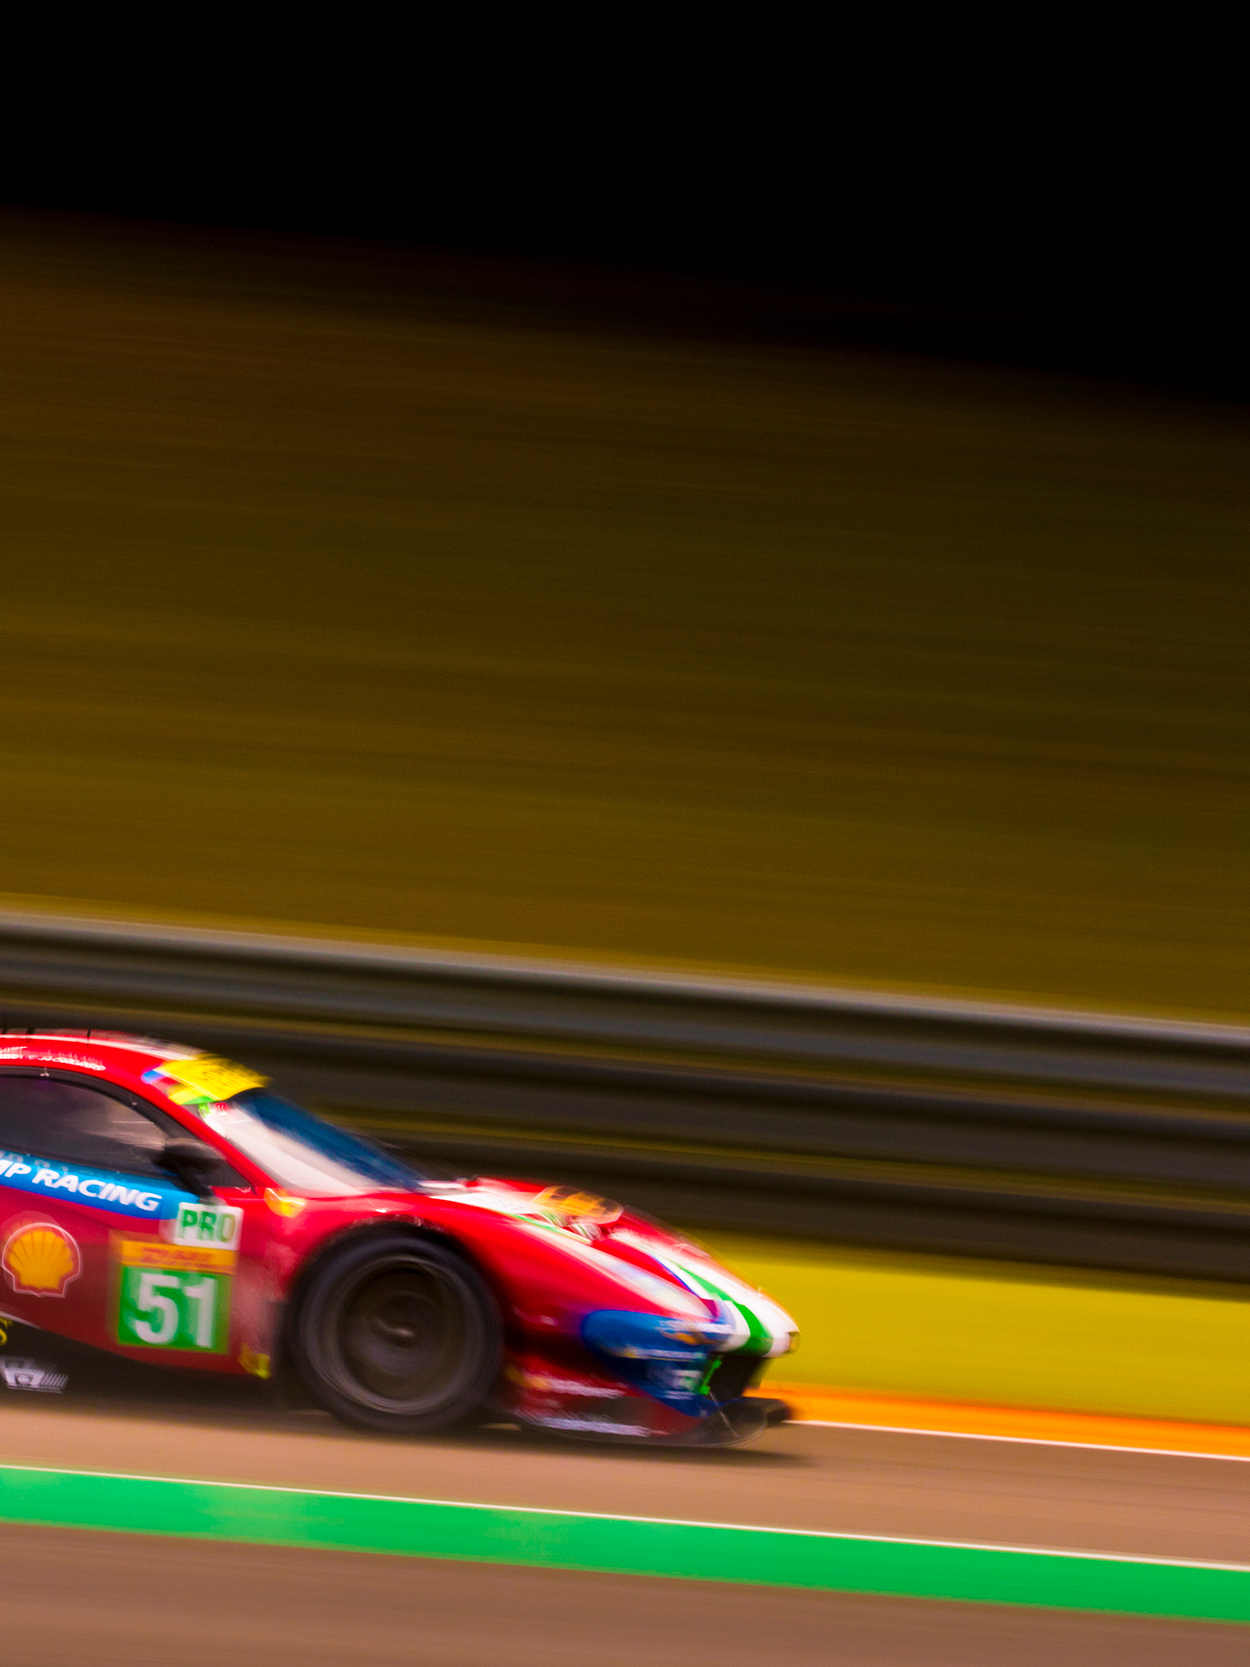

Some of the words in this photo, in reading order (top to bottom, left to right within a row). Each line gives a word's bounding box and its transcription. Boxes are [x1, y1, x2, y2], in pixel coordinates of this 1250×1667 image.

[32, 1168, 163, 1212] RACING
[178, 1208, 237, 1243] PRO
[134, 1272, 219, 1348] 51
